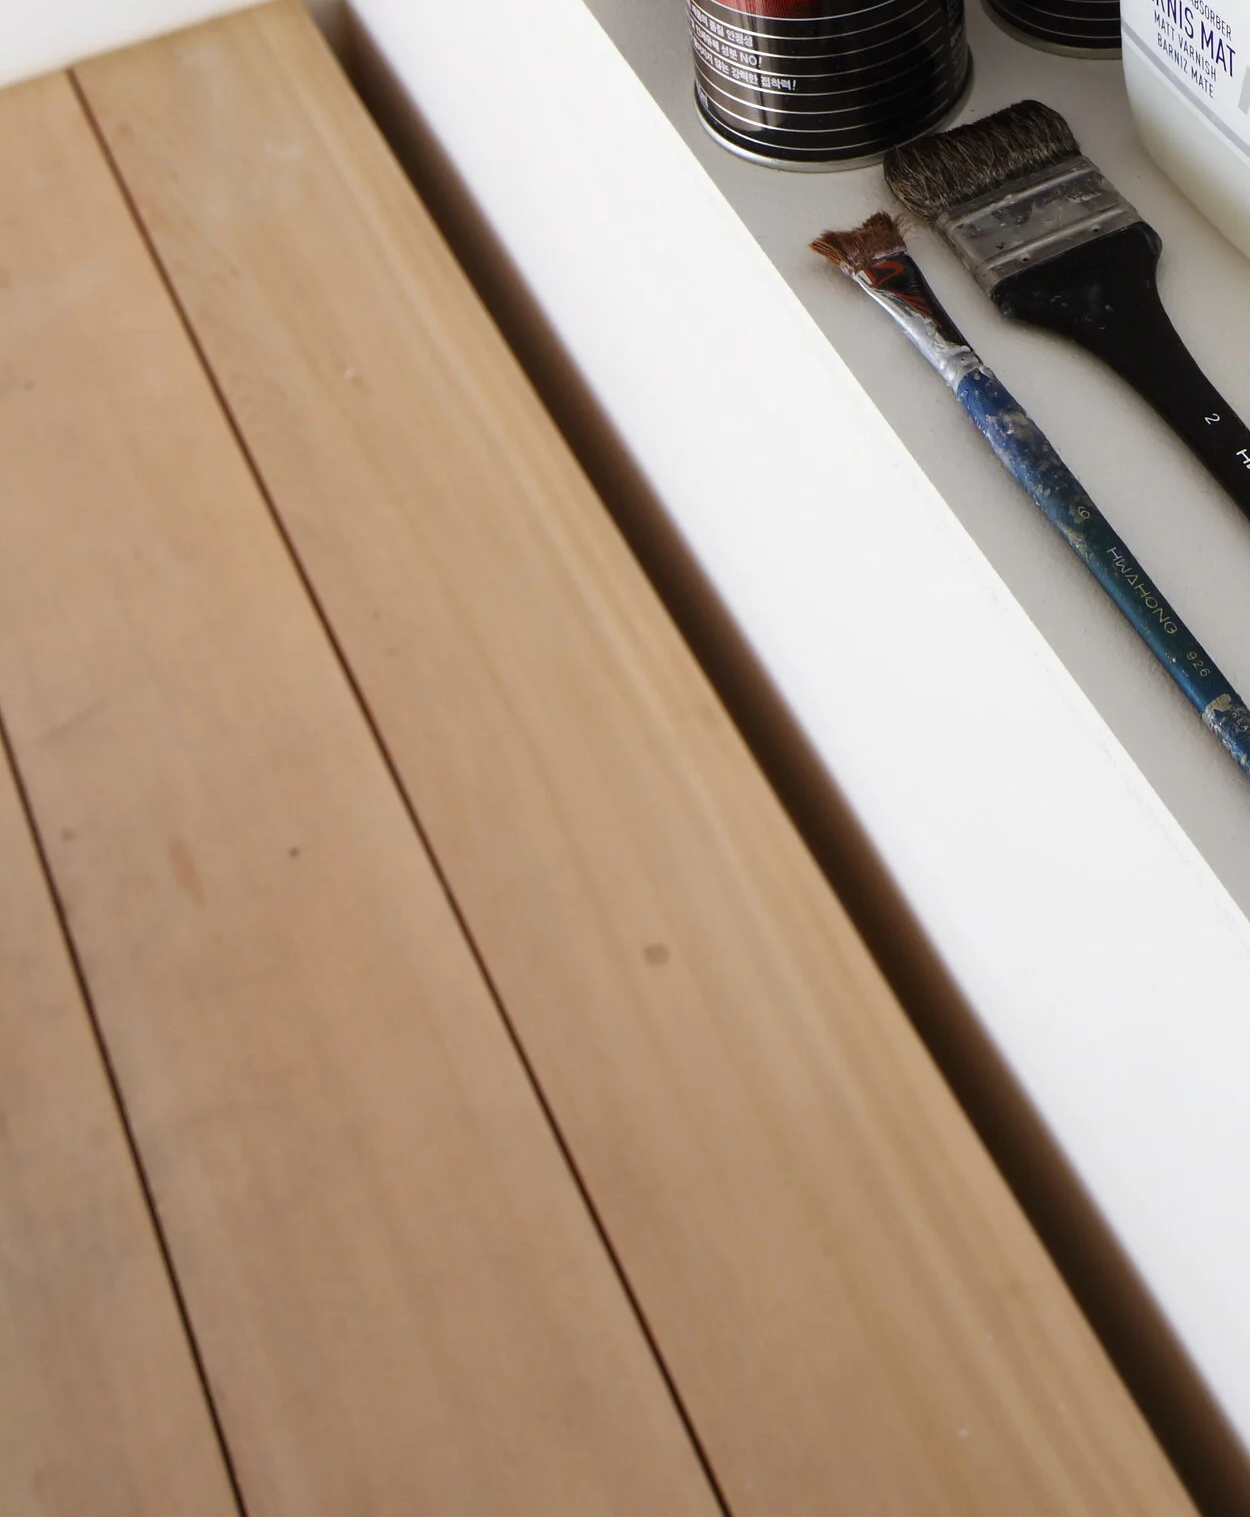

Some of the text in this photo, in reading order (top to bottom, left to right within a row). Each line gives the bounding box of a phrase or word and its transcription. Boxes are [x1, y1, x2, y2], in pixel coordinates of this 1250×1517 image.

[740, 54, 763, 69] NO!
[1153, 10, 1217, 82] MATT VARNISH
[1157, 32, 1214, 99] BARNIZ MATE
[1201, 21, 1236, 78] MAT
[1204, 413, 1220, 425] 2
